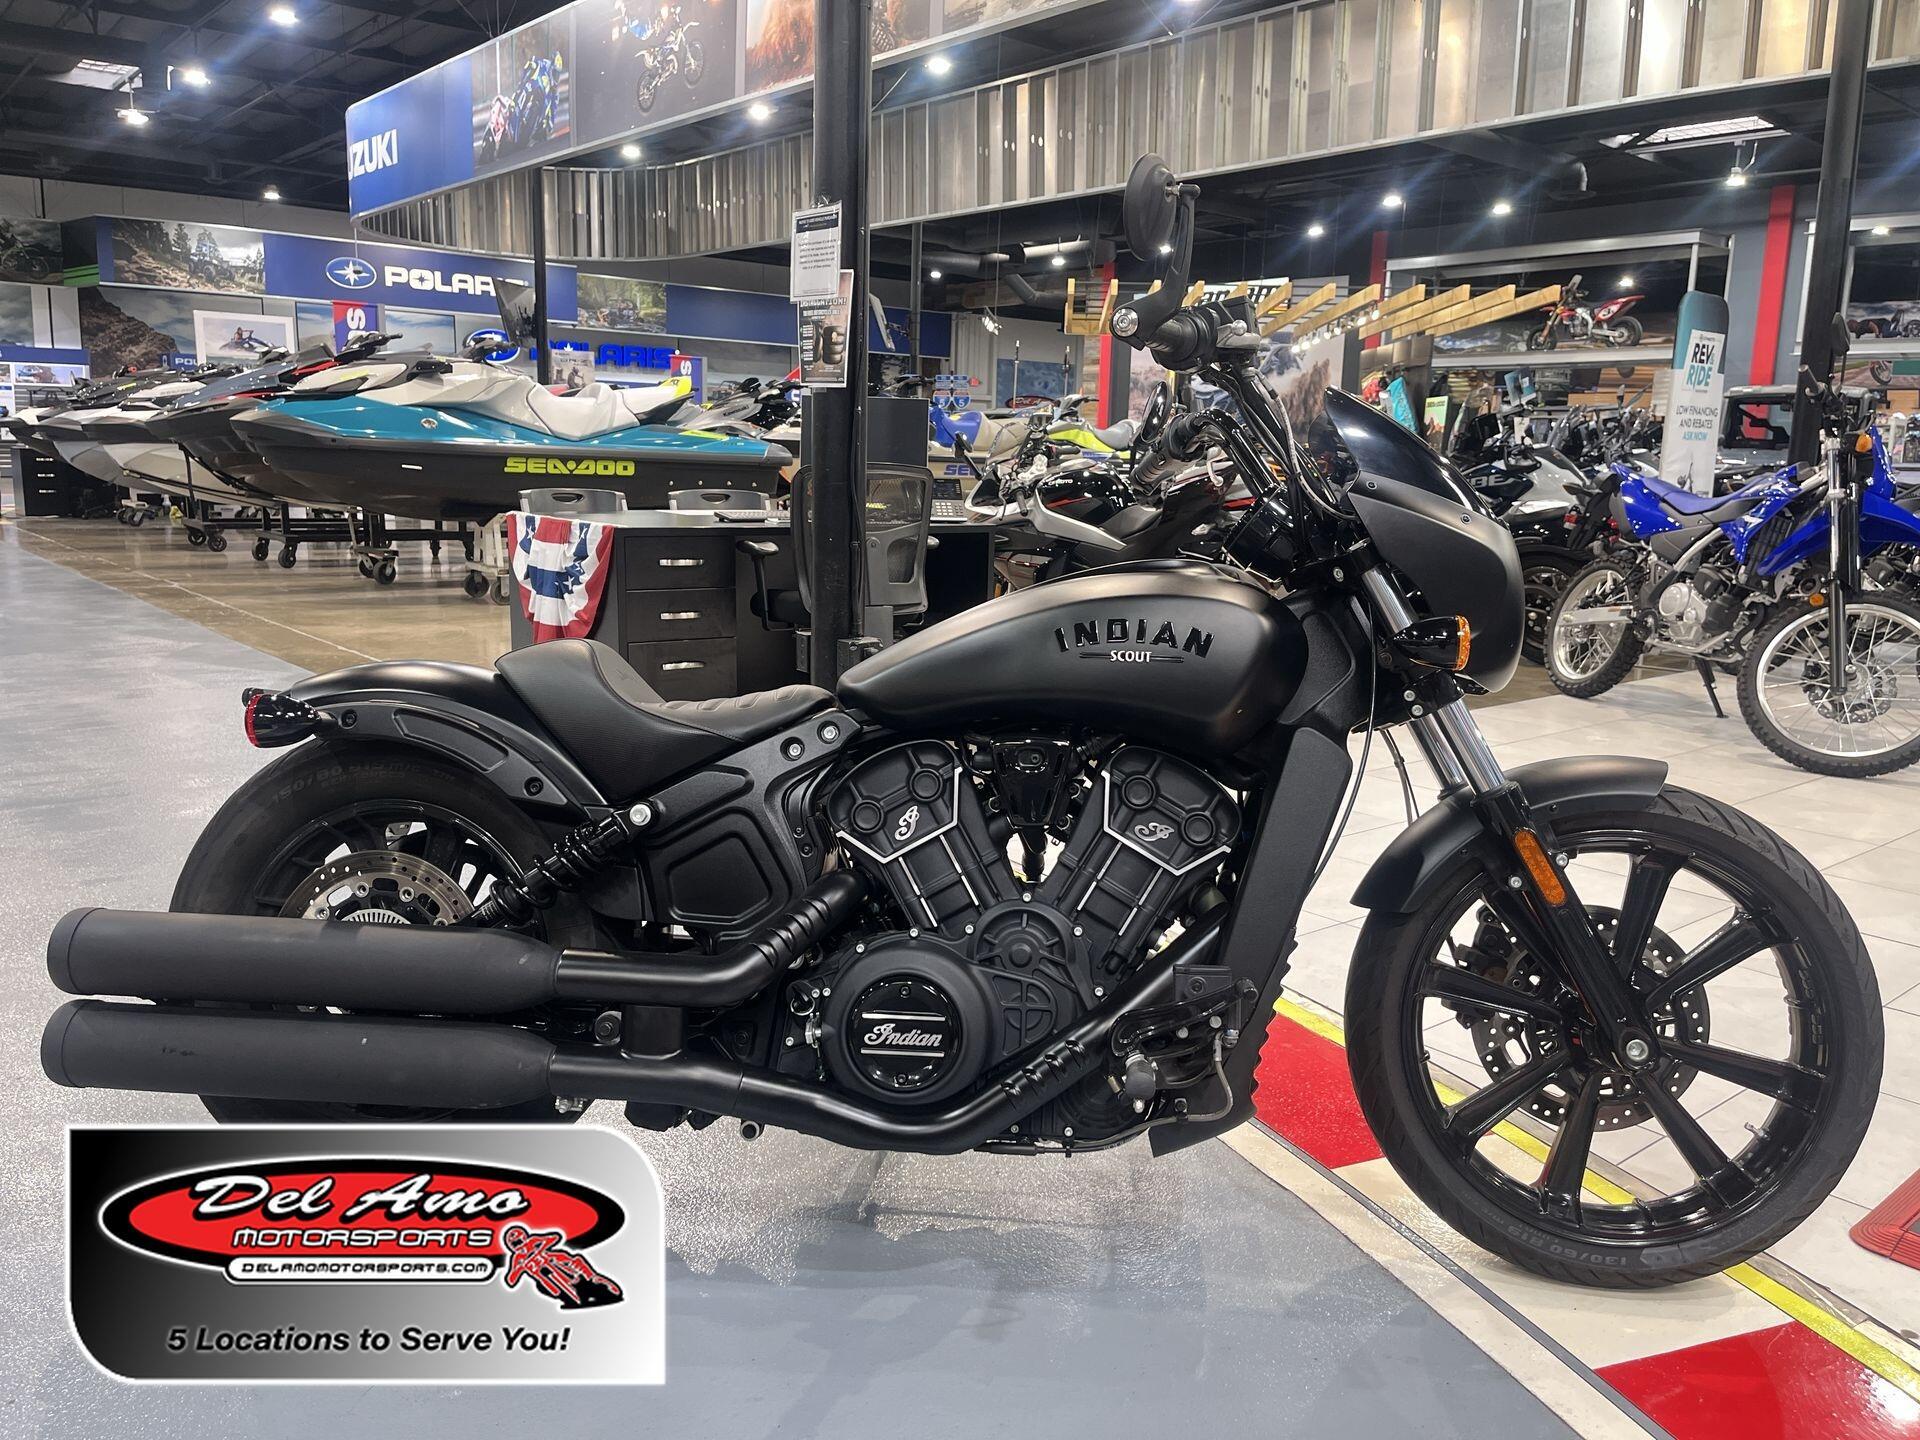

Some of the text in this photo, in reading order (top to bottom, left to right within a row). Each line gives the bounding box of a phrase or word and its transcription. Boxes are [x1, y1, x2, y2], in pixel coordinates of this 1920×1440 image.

[384, 265, 527, 297] POLAR
[1691, 343, 1715, 364] REV
[1686, 365, 1713, 389] RIDE
[958, 399, 965, 407] 5
[1689, 406, 1719, 417] FINANCING
[1679, 419, 1713, 429] AND REBATES
[1054, 618, 1215, 658] INDIAN
[1110, 650, 1152, 663] SCOUT
[863, 1023, 943, 1047] Indian
